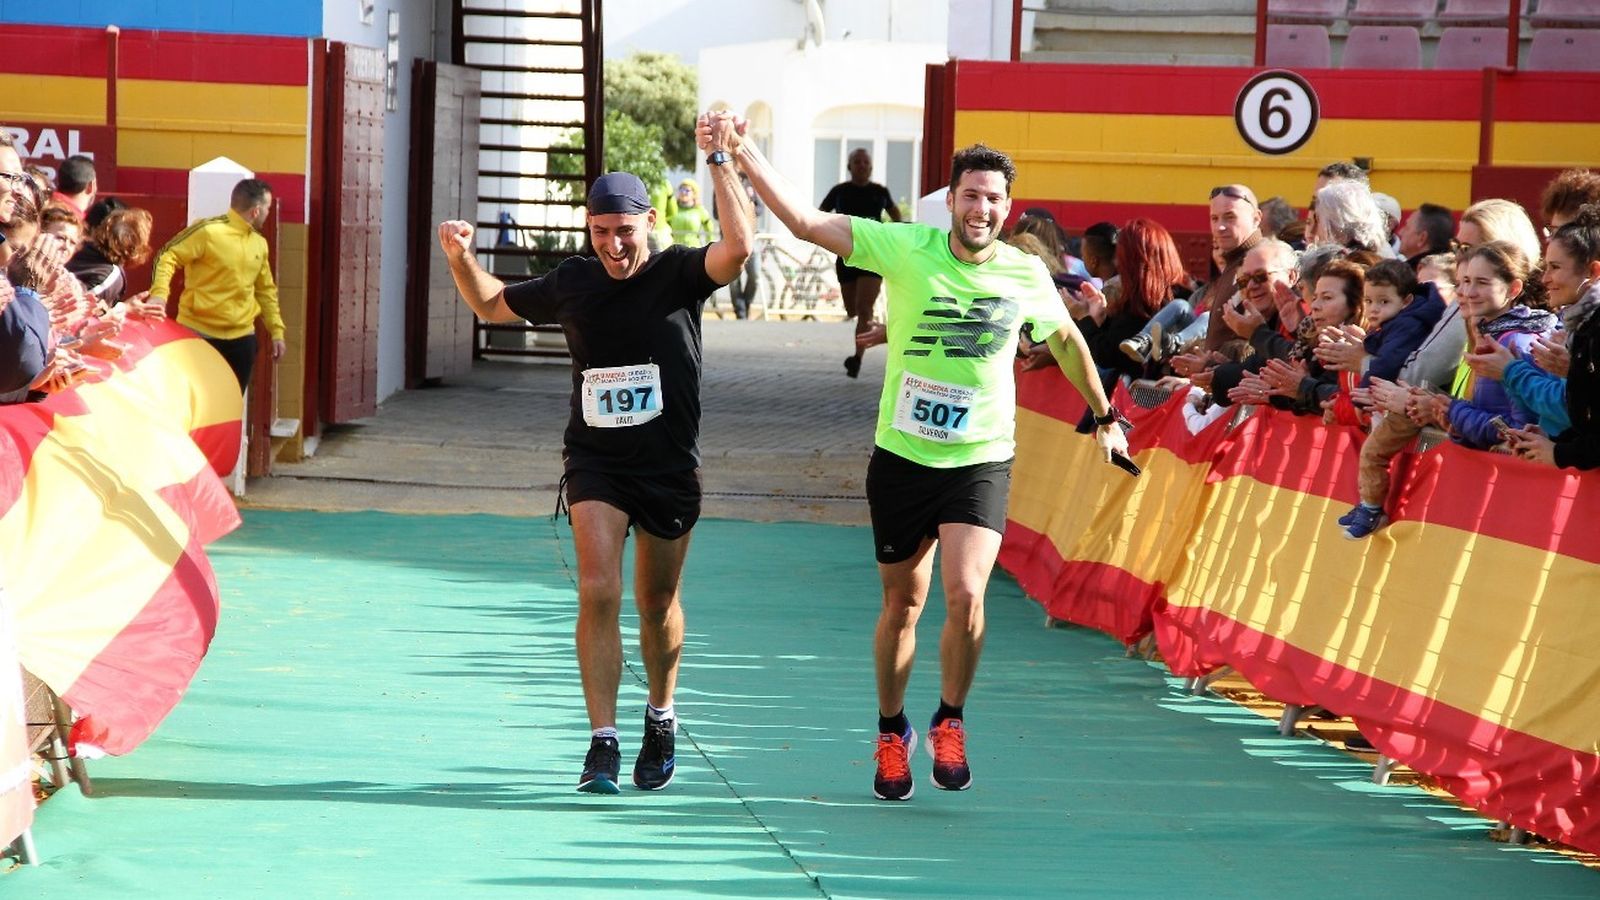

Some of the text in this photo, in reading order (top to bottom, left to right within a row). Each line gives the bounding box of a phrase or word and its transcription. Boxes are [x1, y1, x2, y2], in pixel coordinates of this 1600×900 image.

[1259, 87, 1293, 138] 6
[600, 387, 653, 413] 197
[913, 398, 969, 429] 507
